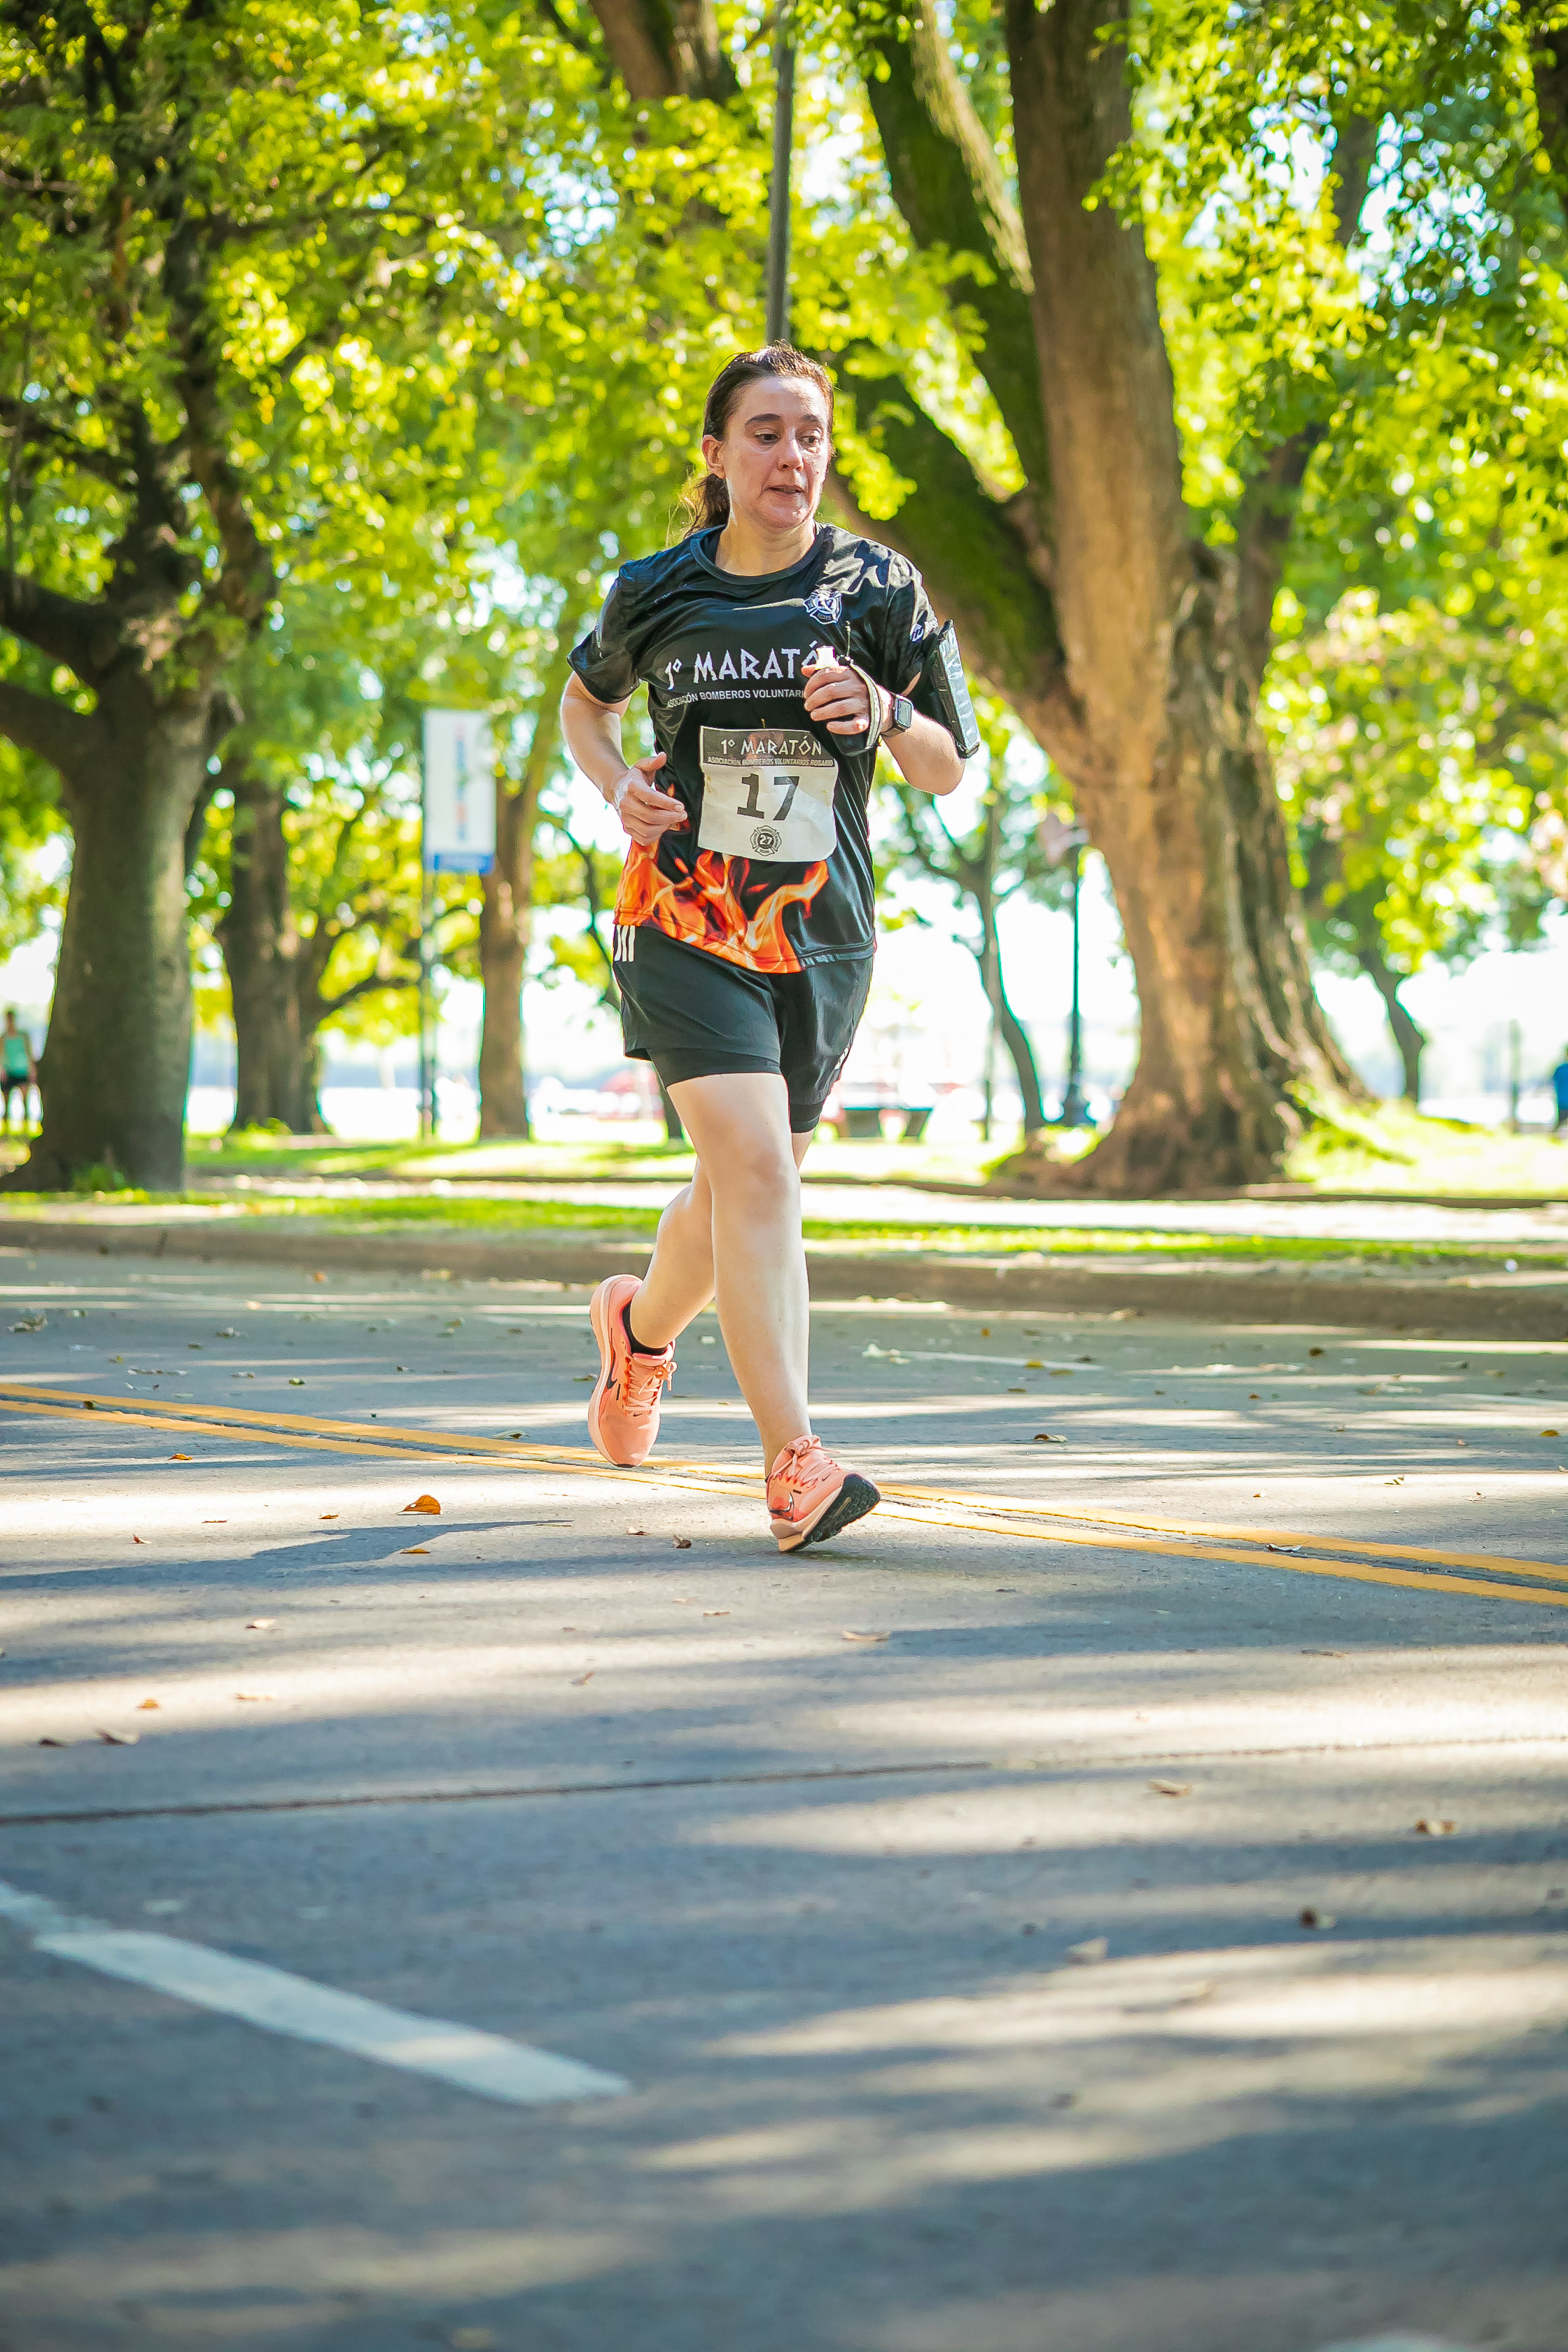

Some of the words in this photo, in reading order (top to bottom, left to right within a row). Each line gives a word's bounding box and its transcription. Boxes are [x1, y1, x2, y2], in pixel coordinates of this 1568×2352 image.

[699, 690, 751, 700] BOMBEROS
[741, 735, 822, 755] MARATÓN
[737, 773, 800, 821] 17
[760, 834, 773, 845] 27
